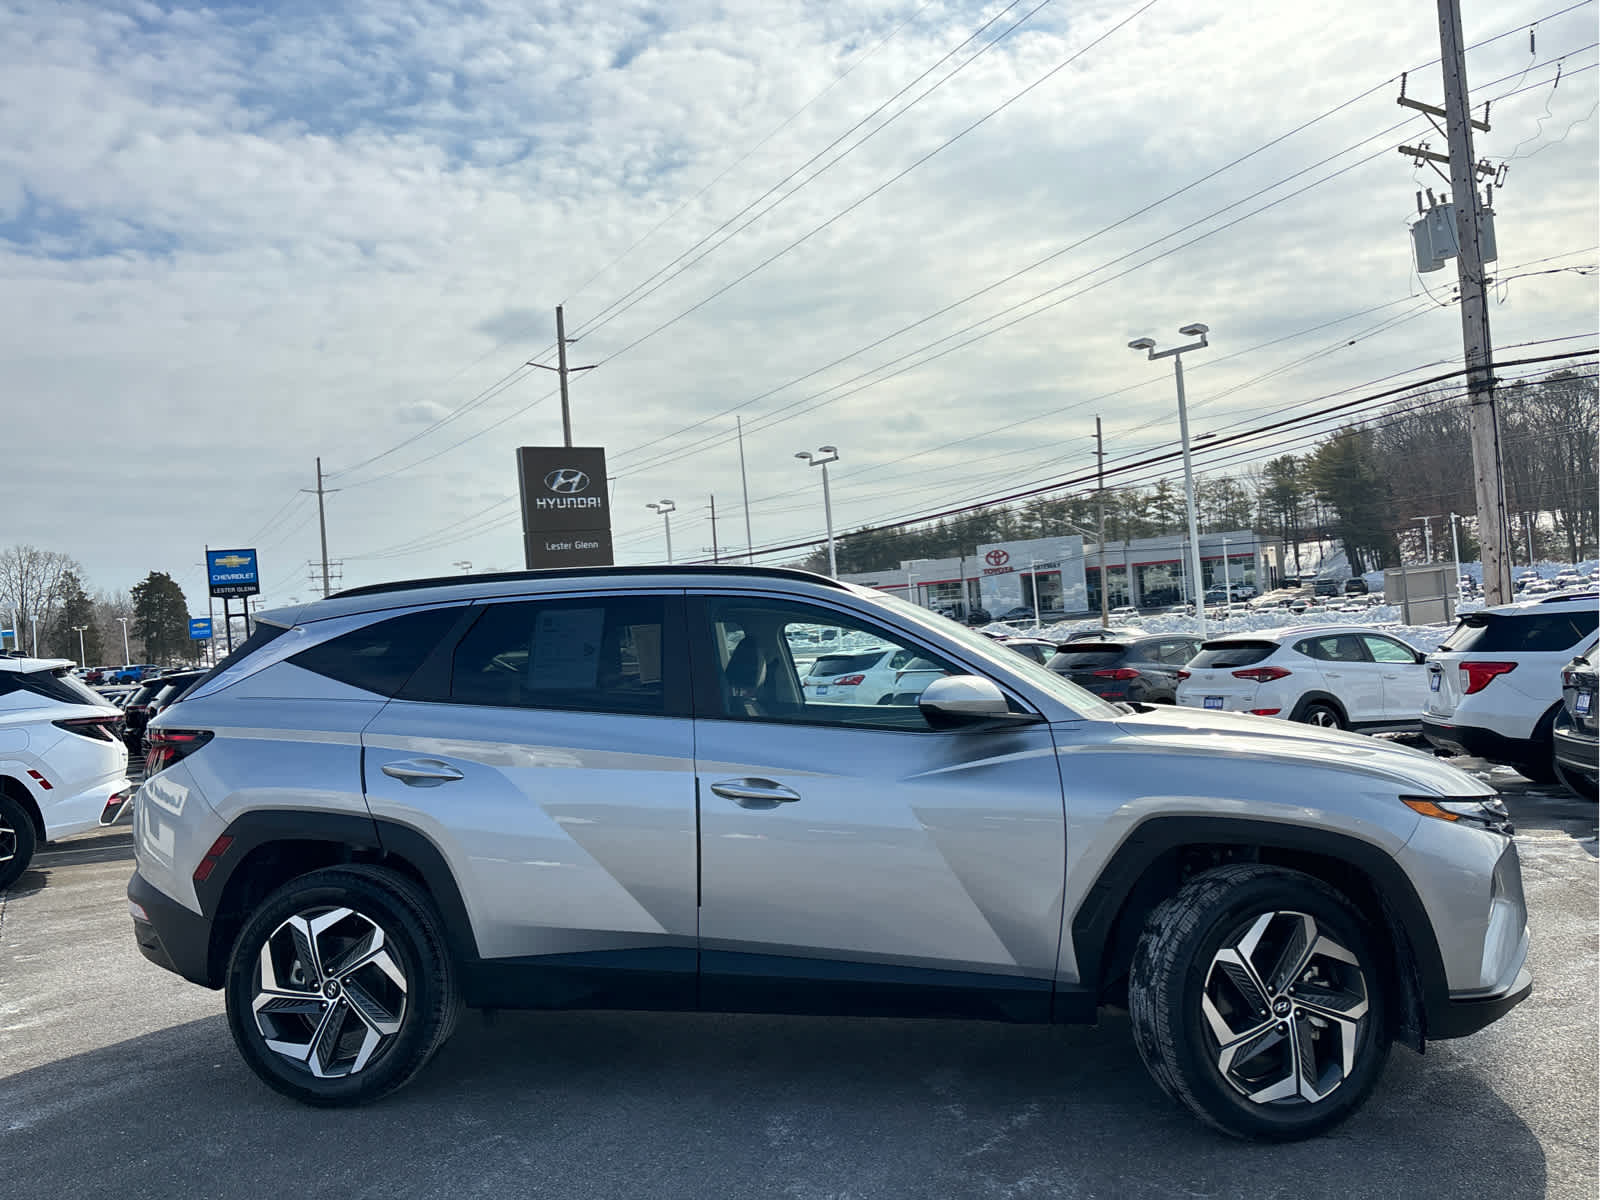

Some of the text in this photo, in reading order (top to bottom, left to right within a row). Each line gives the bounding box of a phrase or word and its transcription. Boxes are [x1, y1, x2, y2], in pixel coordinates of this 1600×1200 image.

[536, 497, 601, 509] HYUNDAI
[546, 541, 599, 551] Lester Glenn
[213, 573, 254, 581] CHEVROLET
